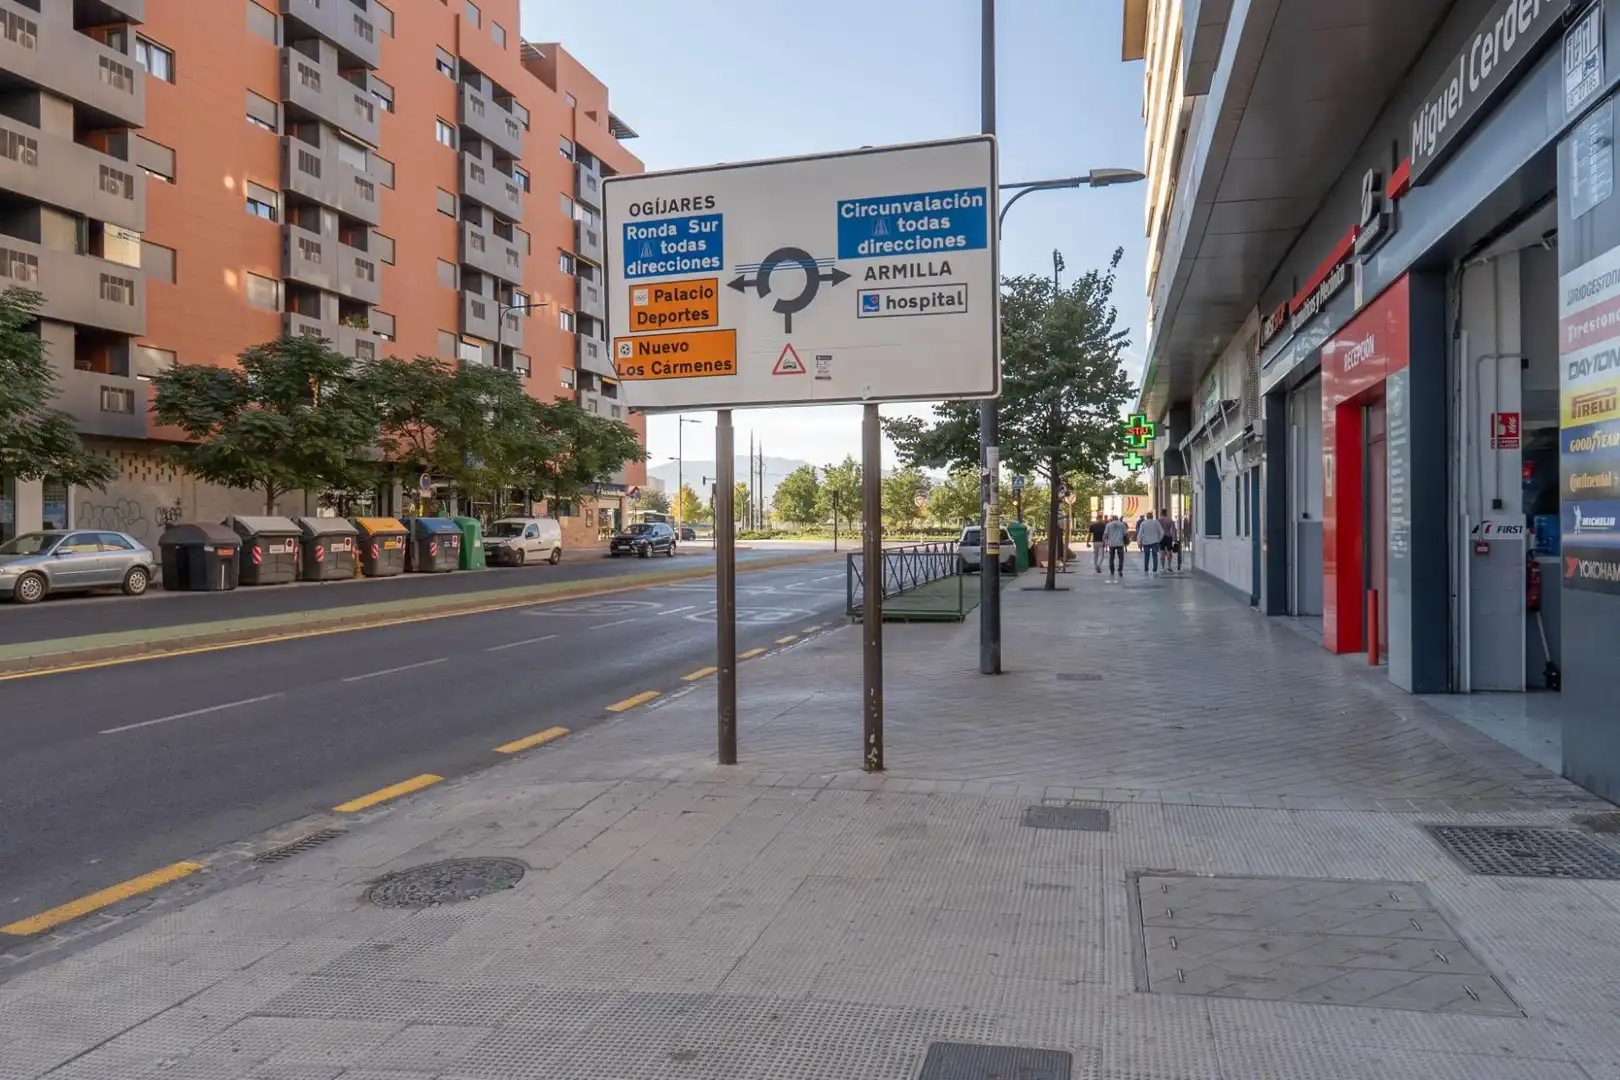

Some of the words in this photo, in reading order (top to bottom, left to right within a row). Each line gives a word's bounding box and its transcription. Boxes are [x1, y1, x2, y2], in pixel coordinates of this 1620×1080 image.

[1411, 54, 1466, 165] Miguel
[629, 195, 716, 217] OGÍJARES
[841, 191, 983, 219] Circunvalación
[627, 223, 677, 240] Ronda
[688, 219, 719, 234] Sur
[897, 216, 950, 233] todas
[660, 239, 706, 255] todas
[858, 234, 966, 255] direcciones
[627, 256, 720, 275] direcciones
[864, 260, 952, 281] ARMILLA
[654, 285, 714, 303] Palacio
[886, 291, 964, 311] hospital
[637, 308, 710, 327] Deportes
[638, 341, 689, 356] Nuevo
[617, 363, 645, 377] Los
[651, 356, 732, 374] Cármenes
[1571, 386, 1617, 419] PIRELLI
[1570, 471, 1612, 492] Continental
[1581, 517, 1616, 527] MICHELIN
